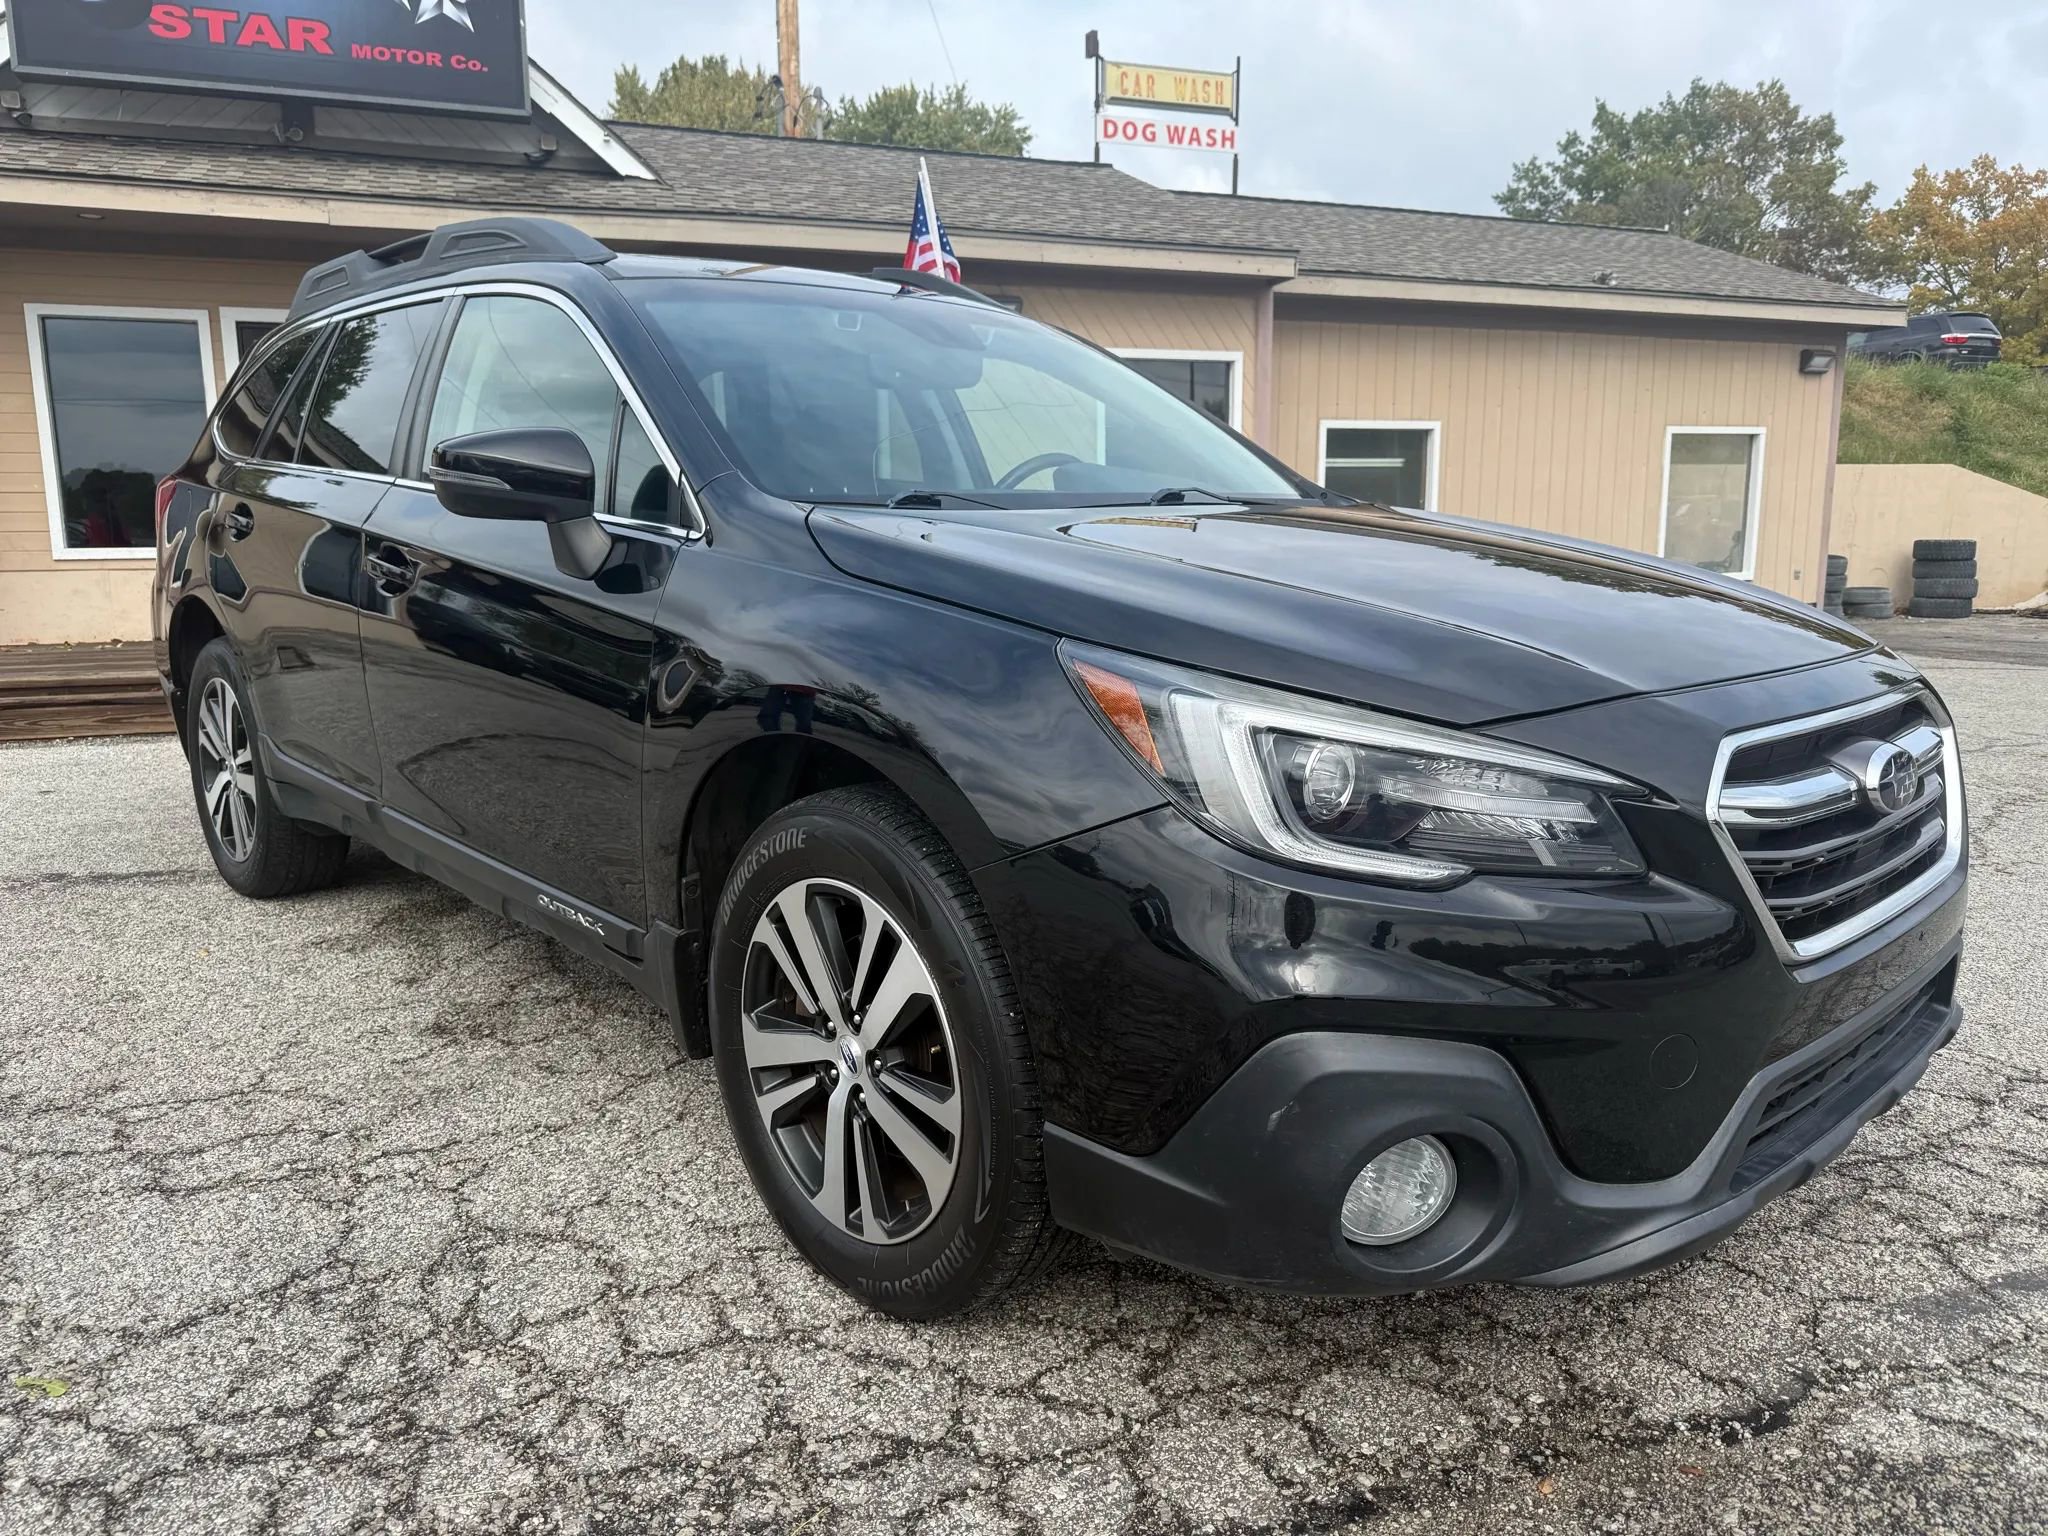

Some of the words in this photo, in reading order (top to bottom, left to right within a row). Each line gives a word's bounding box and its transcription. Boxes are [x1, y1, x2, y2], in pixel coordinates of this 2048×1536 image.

[148, 4, 335, 55] STAR
[351, 43, 443, 67] MOTOR
[450, 54, 488, 72] Co.
[1120, 71, 1155, 98] CAR
[1174, 76, 1224, 105] WASH
[1103, 119, 1157, 142] DOG
[1166, 124, 1235, 149] WASH
[720, 826, 809, 926] BRIDGESTONE
